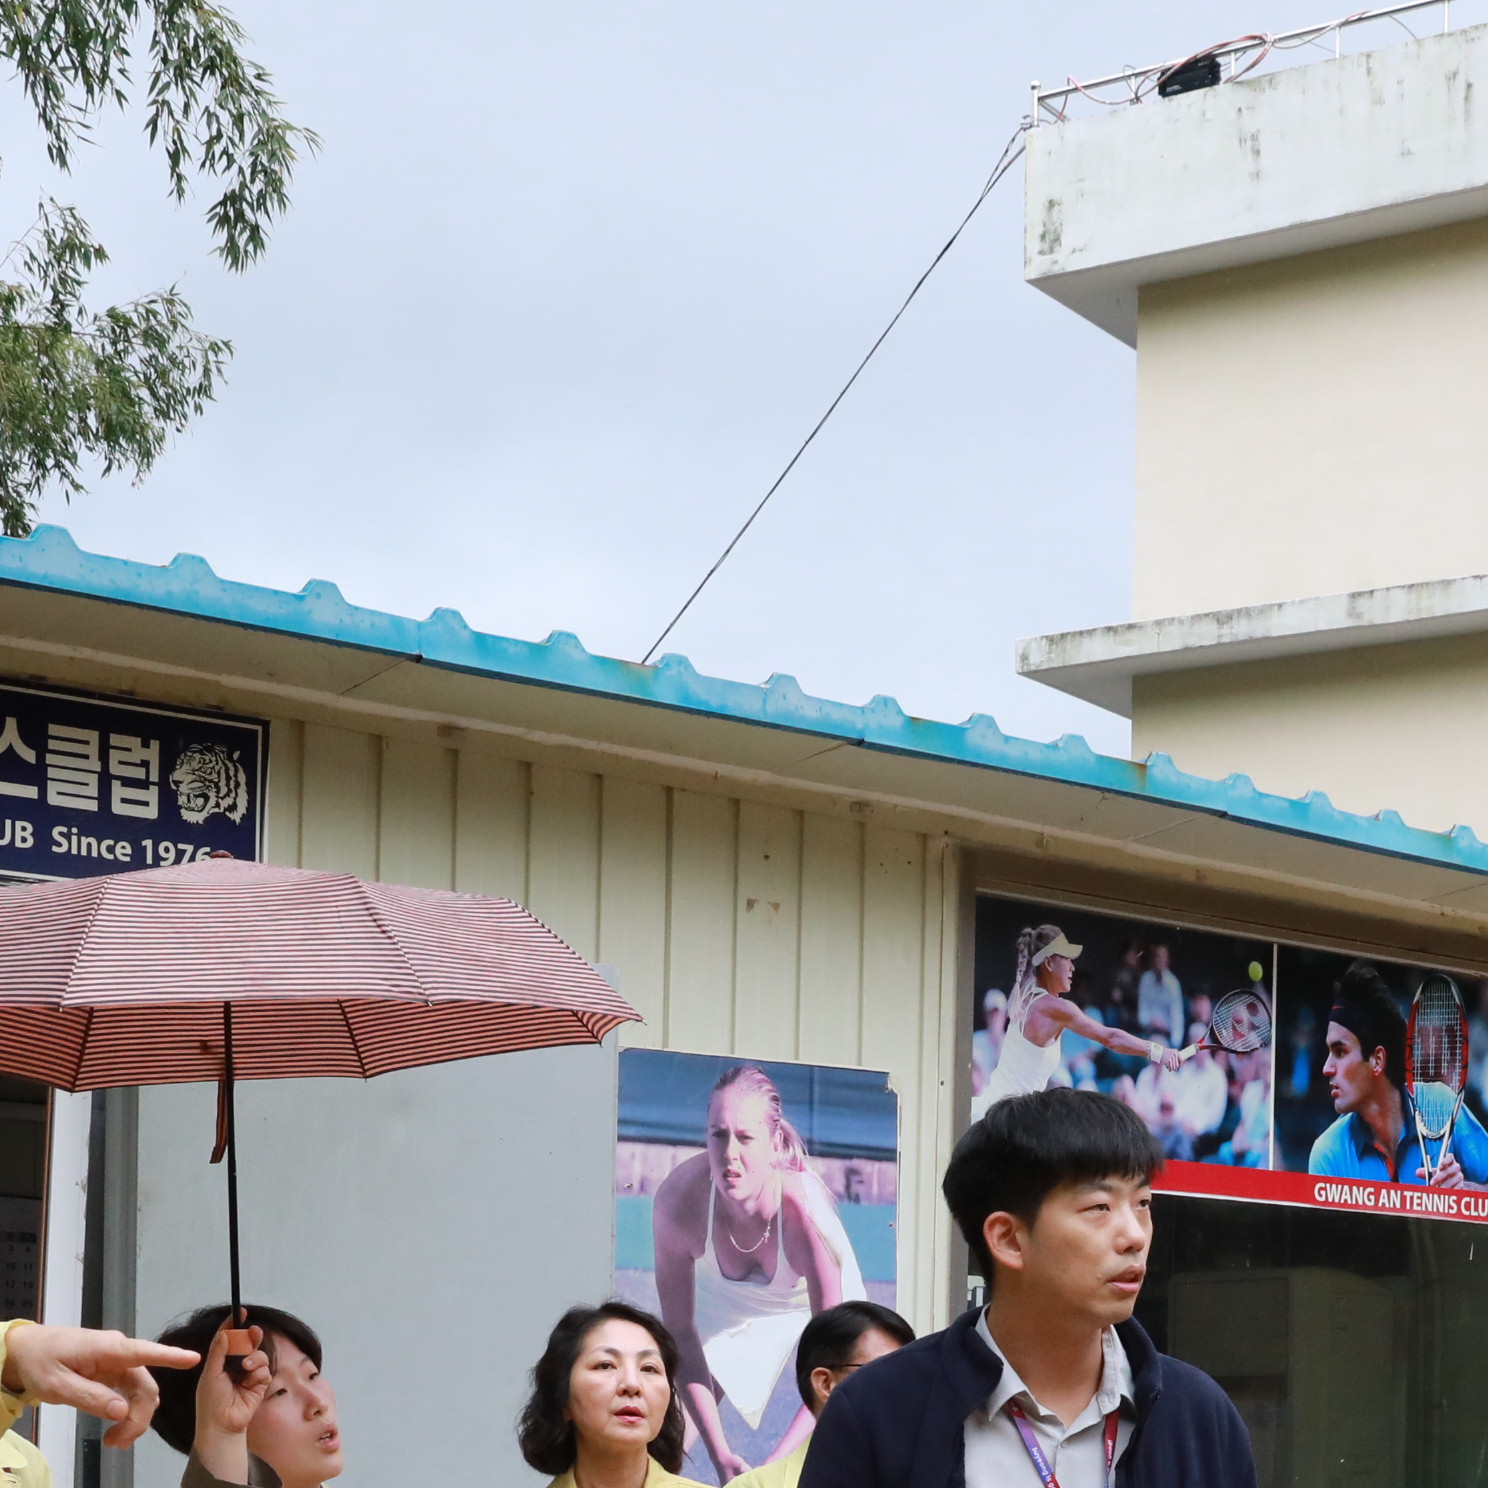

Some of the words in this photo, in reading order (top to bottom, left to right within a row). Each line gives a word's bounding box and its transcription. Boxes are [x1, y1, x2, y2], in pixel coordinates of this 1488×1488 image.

[51, 823, 133, 863] Since
[1313, 1182, 1375, 1206] GWANG
[1378, 1188, 1402, 1209] AN
[1403, 1190, 1458, 1214] TENNIS
[1031, 1446, 1048, 1477] suyeong
